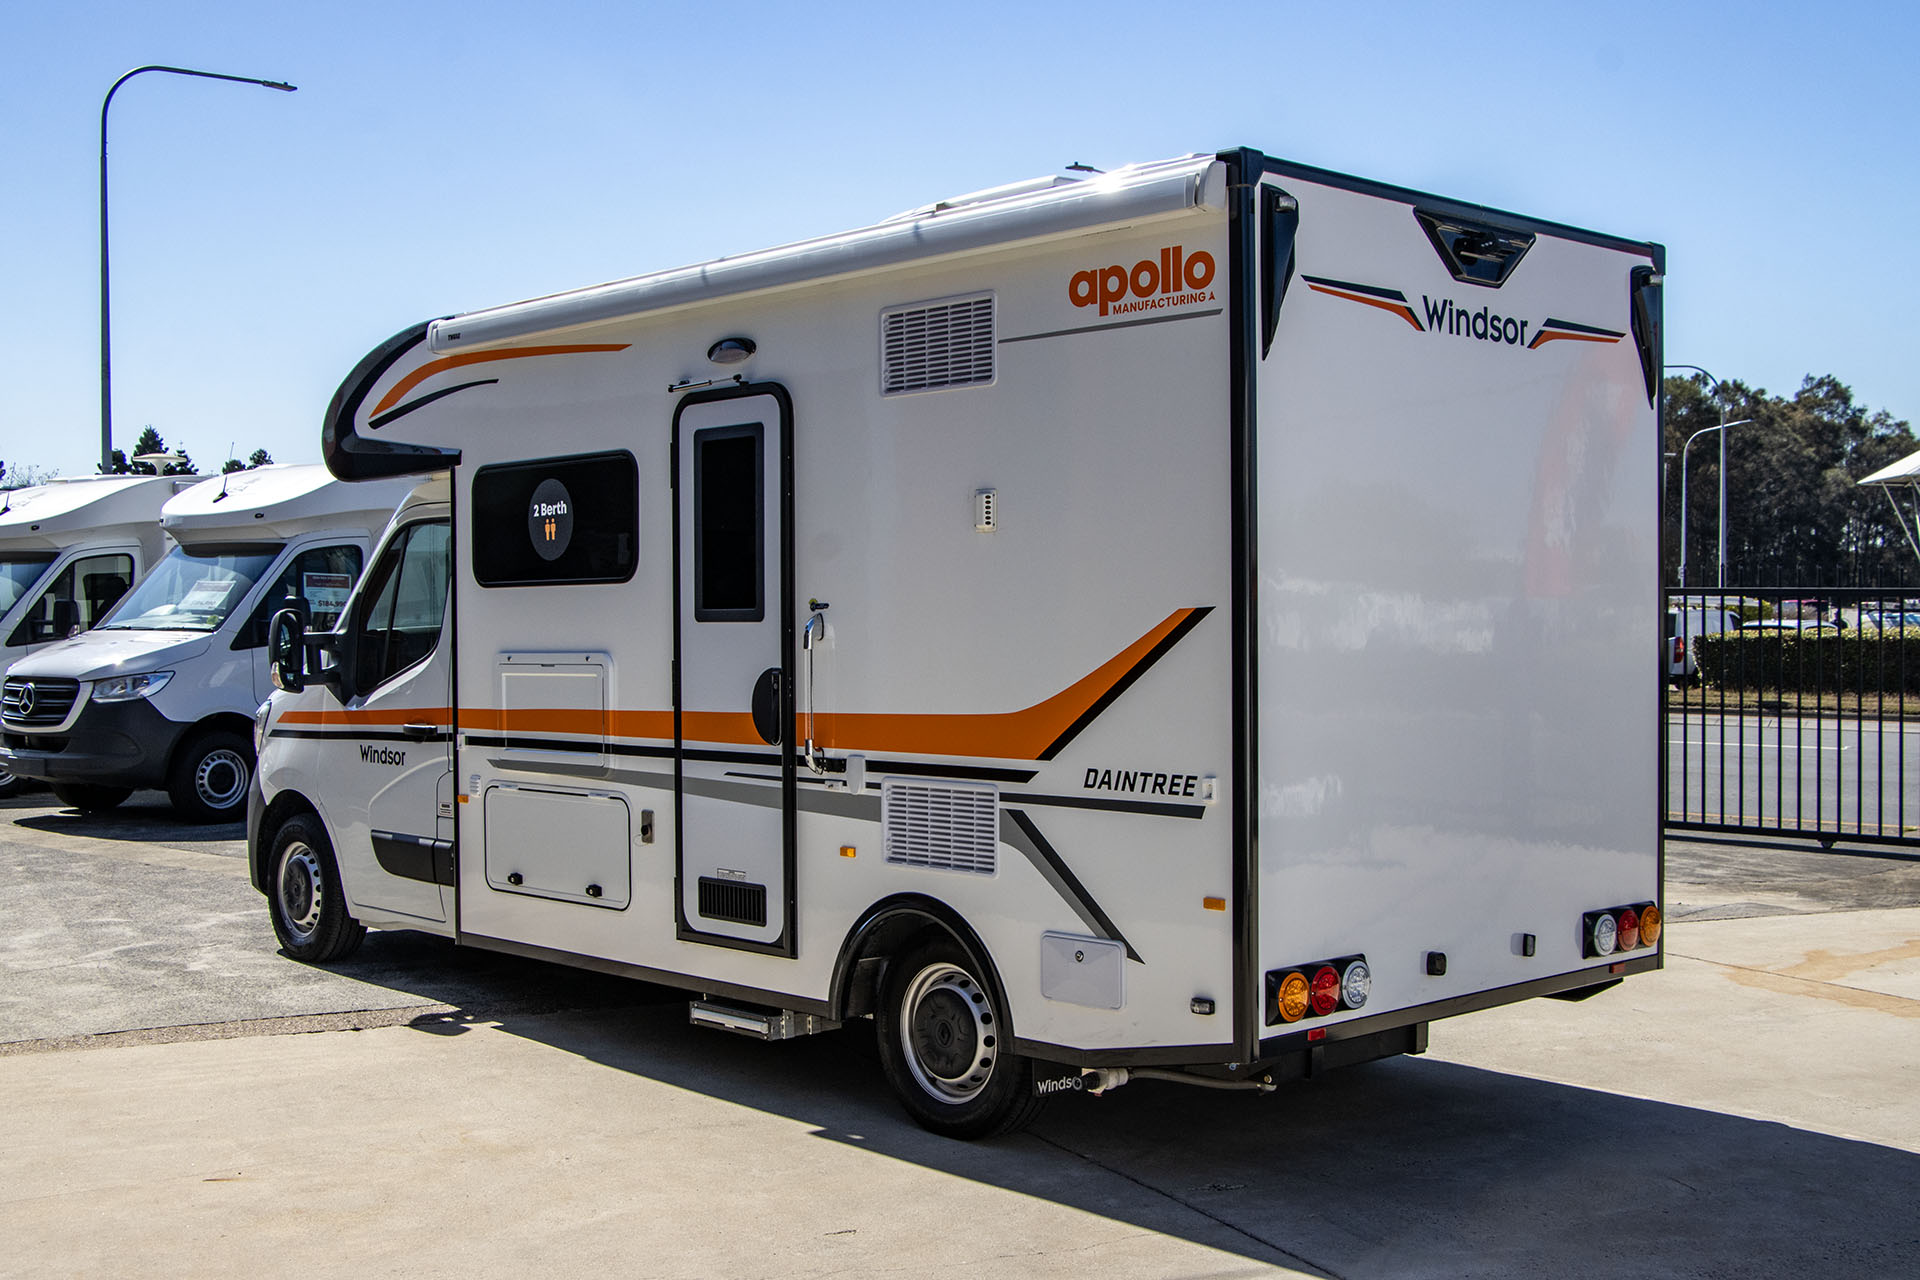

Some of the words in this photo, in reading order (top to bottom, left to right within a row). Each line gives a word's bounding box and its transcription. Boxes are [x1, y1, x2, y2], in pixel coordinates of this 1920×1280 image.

[1068, 245, 1216, 317] apollo
[1112, 291, 1206, 315] MANUFACTURING
[1422, 294, 1529, 346] Windsor
[533, 504, 539, 517] 2
[540, 500, 567, 516] Berth
[360, 744, 406, 766] Windsor
[1083, 768, 1198, 797] DAINTREE
